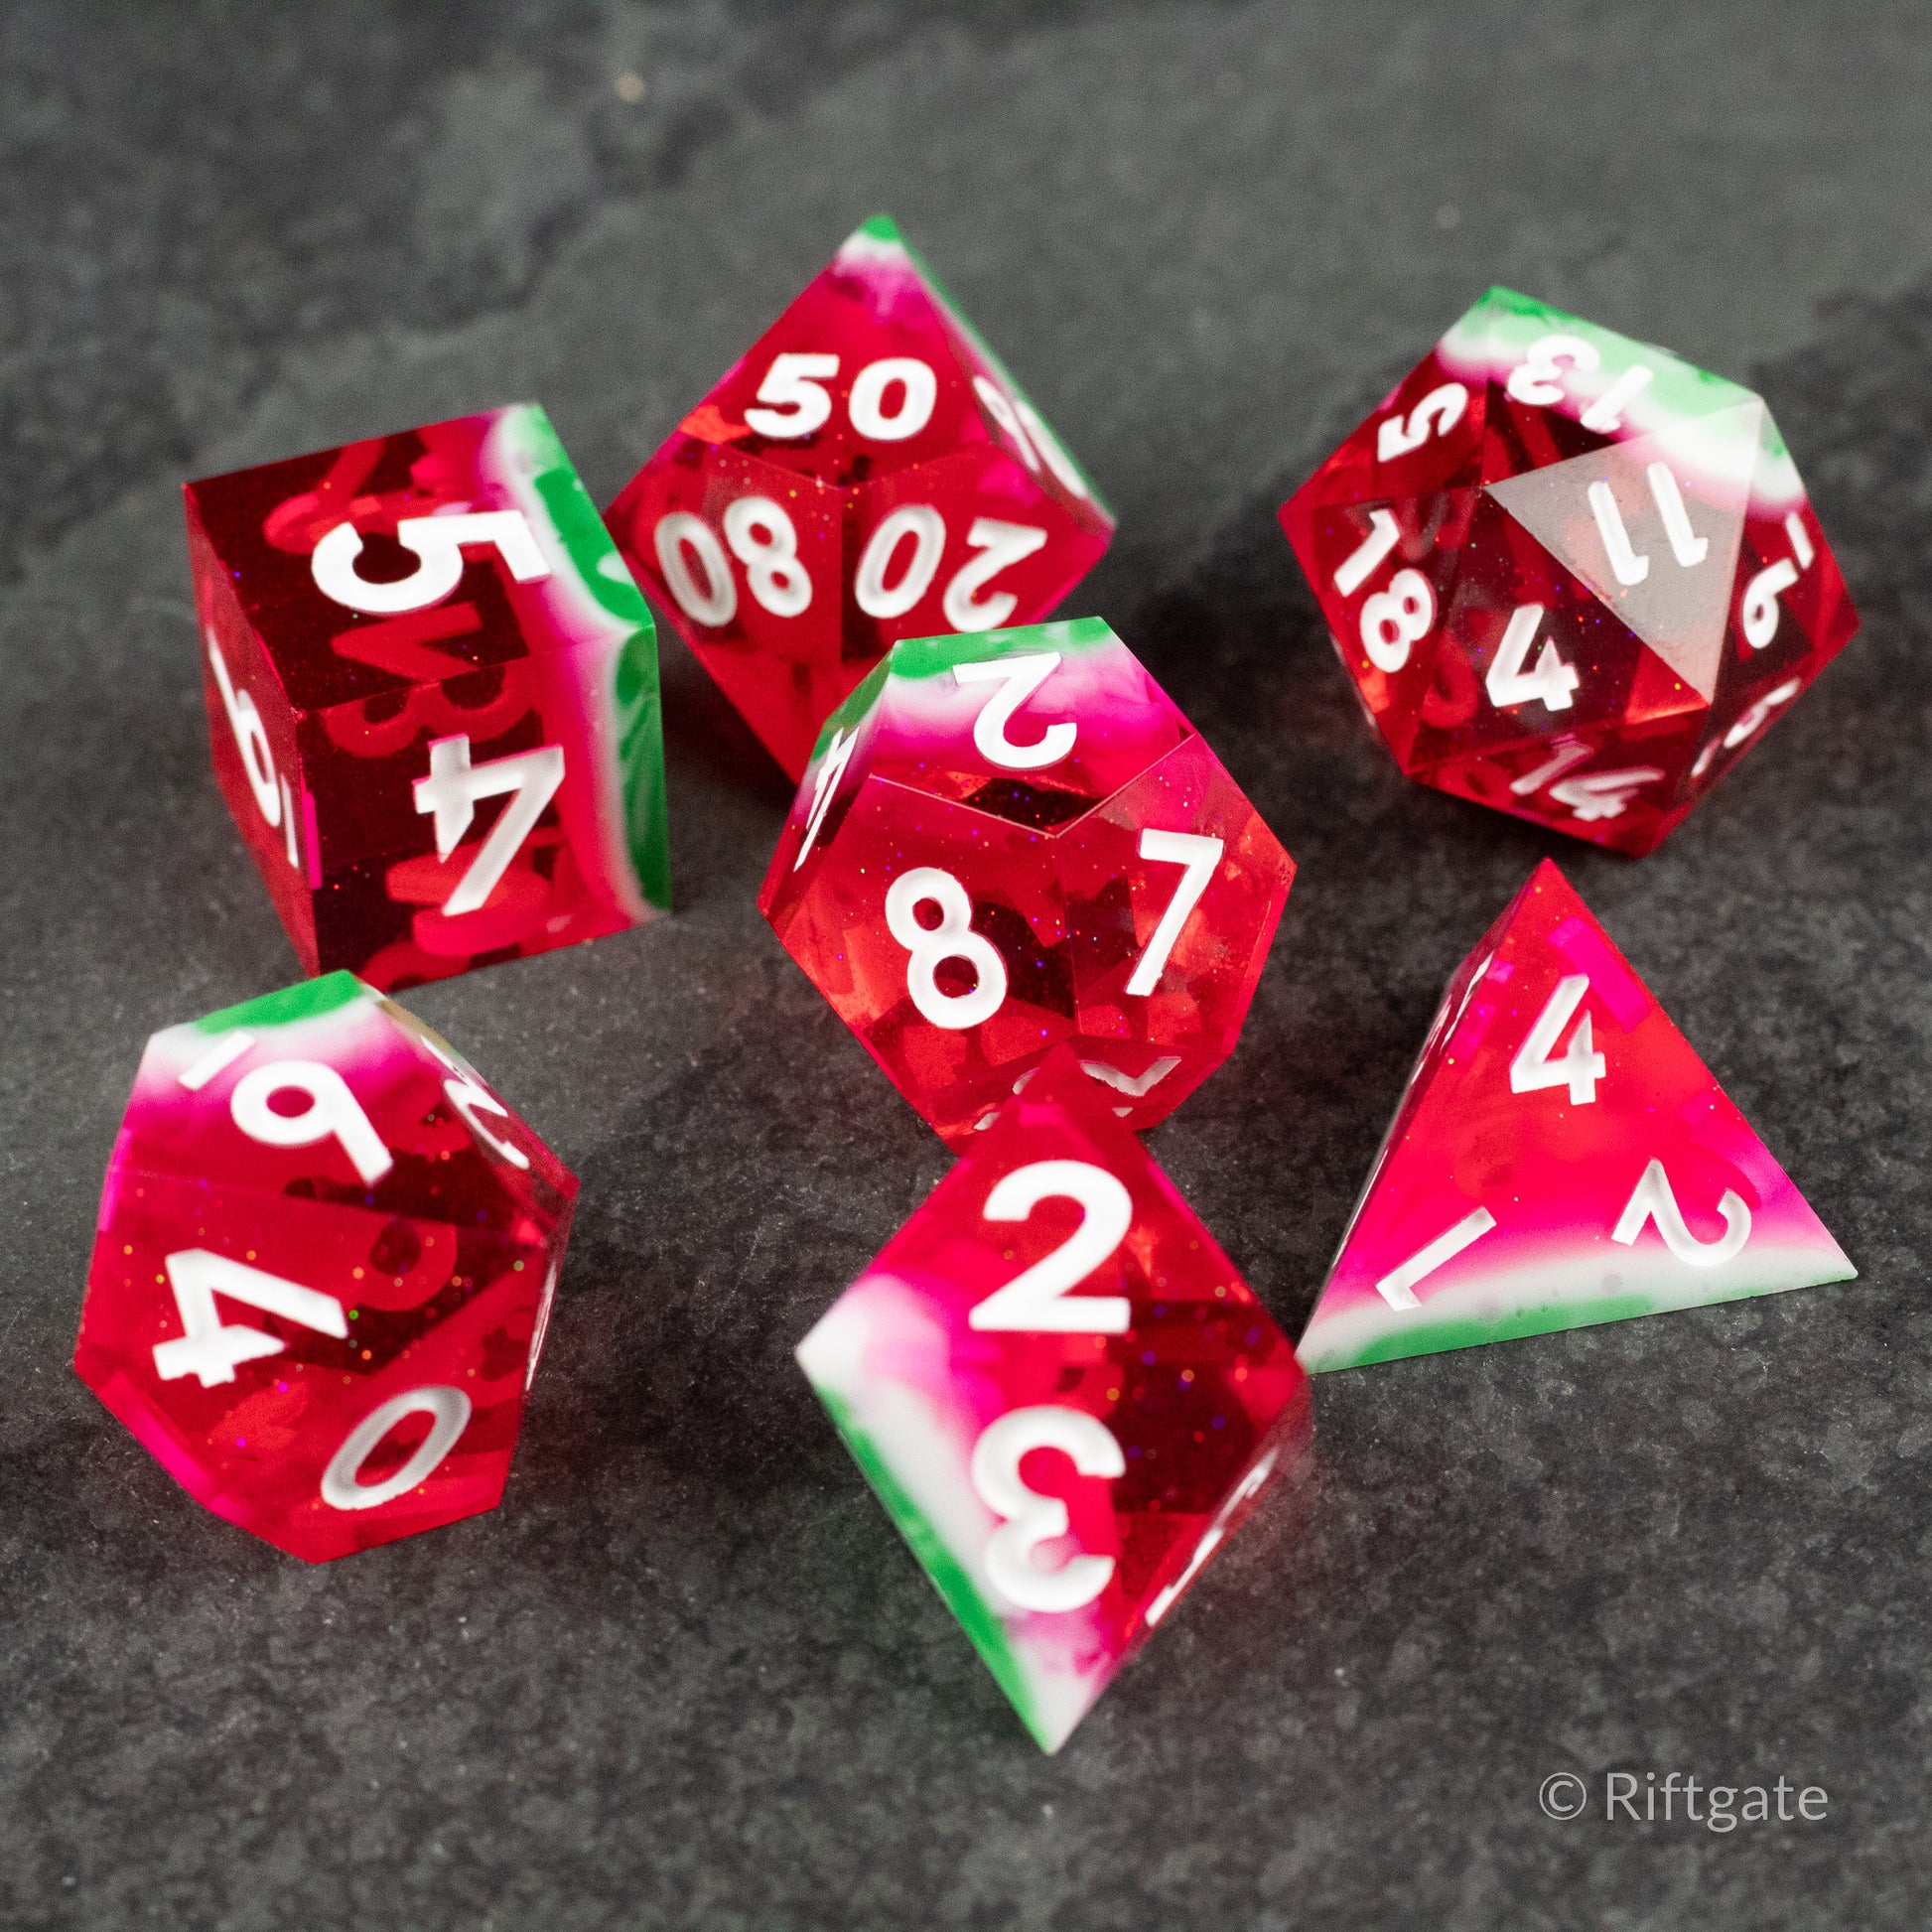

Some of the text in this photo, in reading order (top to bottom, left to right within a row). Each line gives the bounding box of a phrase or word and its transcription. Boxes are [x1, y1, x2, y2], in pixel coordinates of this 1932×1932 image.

[745, 353, 938, 442] 50
[1378, 382, 1469, 464] 5
[1507, 335, 1653, 433] 13
[311, 509, 553, 614] 5
[855, 504, 1047, 633] 20
[1587, 461, 1708, 587] 11
[1333, 507, 1437, 673] 18
[953, 651, 1077, 769] 2
[1485, 603, 1581, 712] 4
[413, 733, 566, 916] 4
[793, 726, 860, 872] 4
[885, 867, 1009, 1030] 8
[1125, 828, 1224, 997] 7
[1510, 973, 1606, 1106] 4
[969, 1159, 1132, 1334] 2
[1376, 1205, 1497, 1311] 1
[1611, 1157, 1752, 1268] 2
[152, 1248, 348, 1389] 4
[320, 1385, 473, 1511] 0
[971, 1405, 1126, 1613] 3
